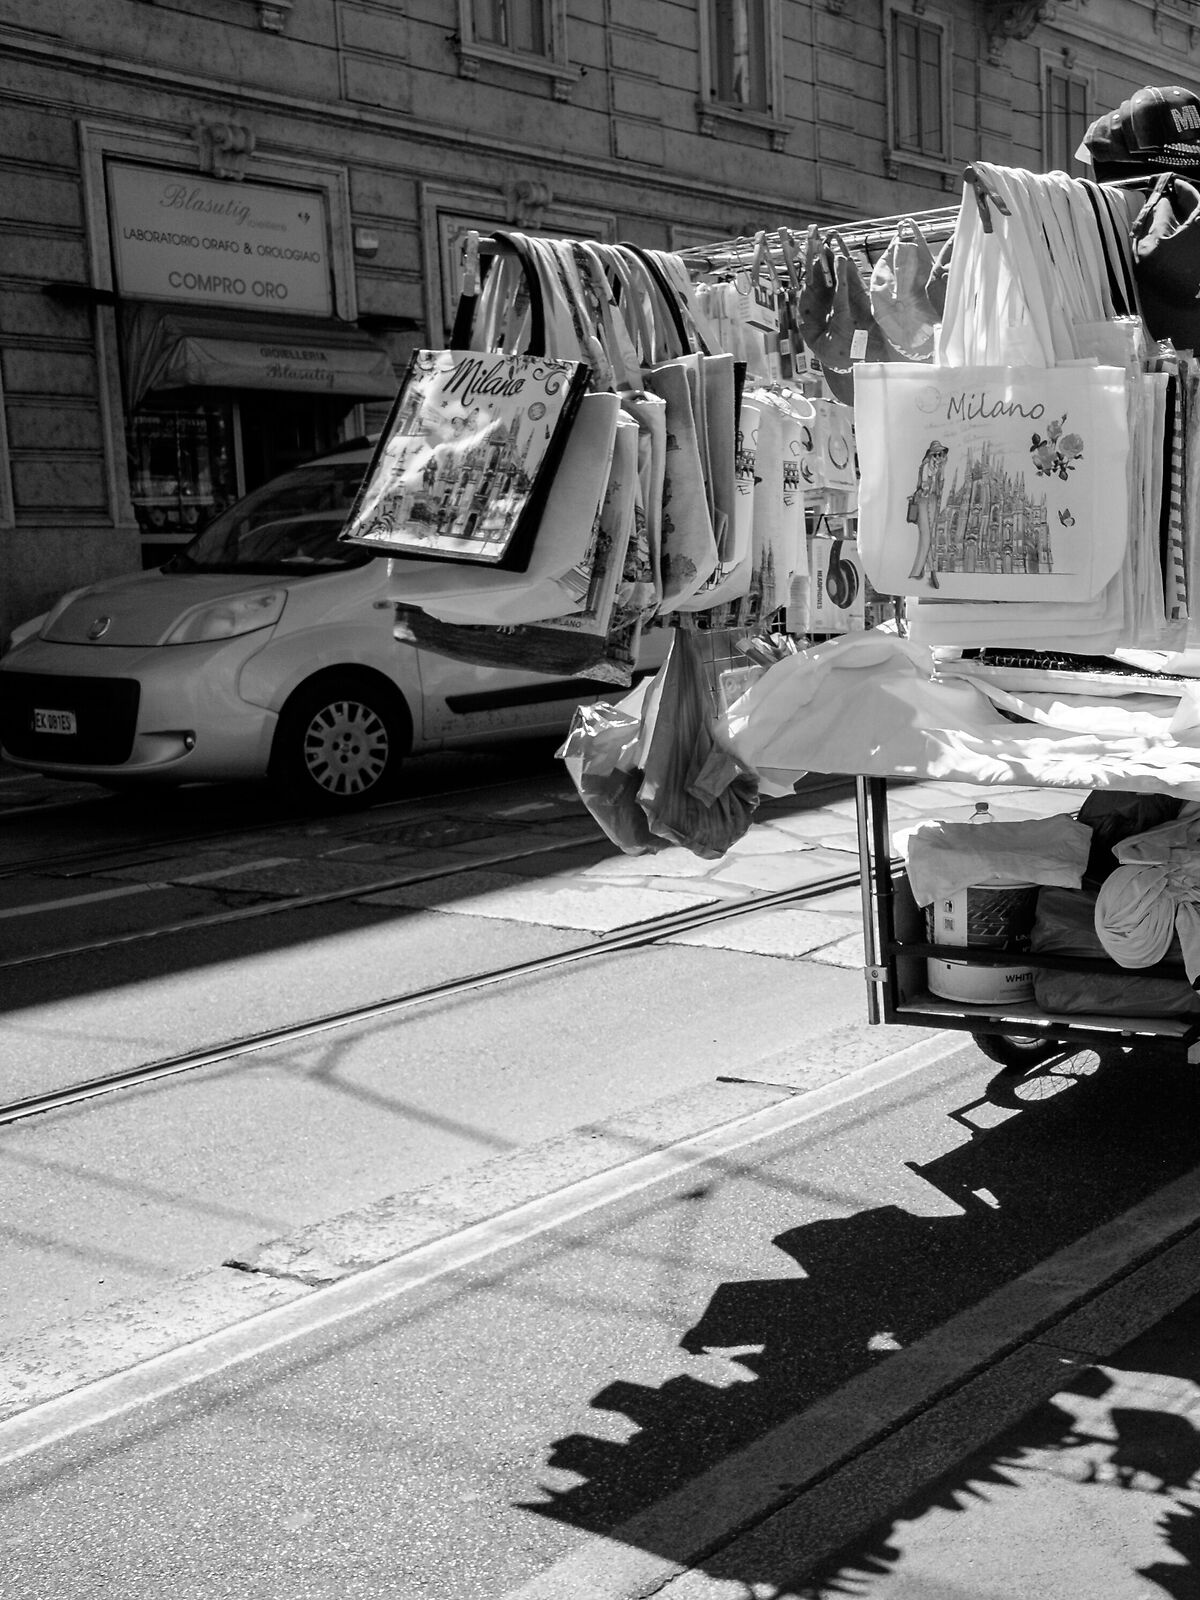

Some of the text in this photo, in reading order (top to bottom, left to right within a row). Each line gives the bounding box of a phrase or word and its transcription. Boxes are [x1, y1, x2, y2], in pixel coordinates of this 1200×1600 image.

[122, 227, 321, 264] LABORATORIO ORAFO & OROLOGIAIO
[168, 270, 289, 300] COMPRO ORO
[260, 348, 328, 361] GIOIELLERIA
[441, 357, 526, 407] Milano
[947, 392, 1045, 421] Milano
